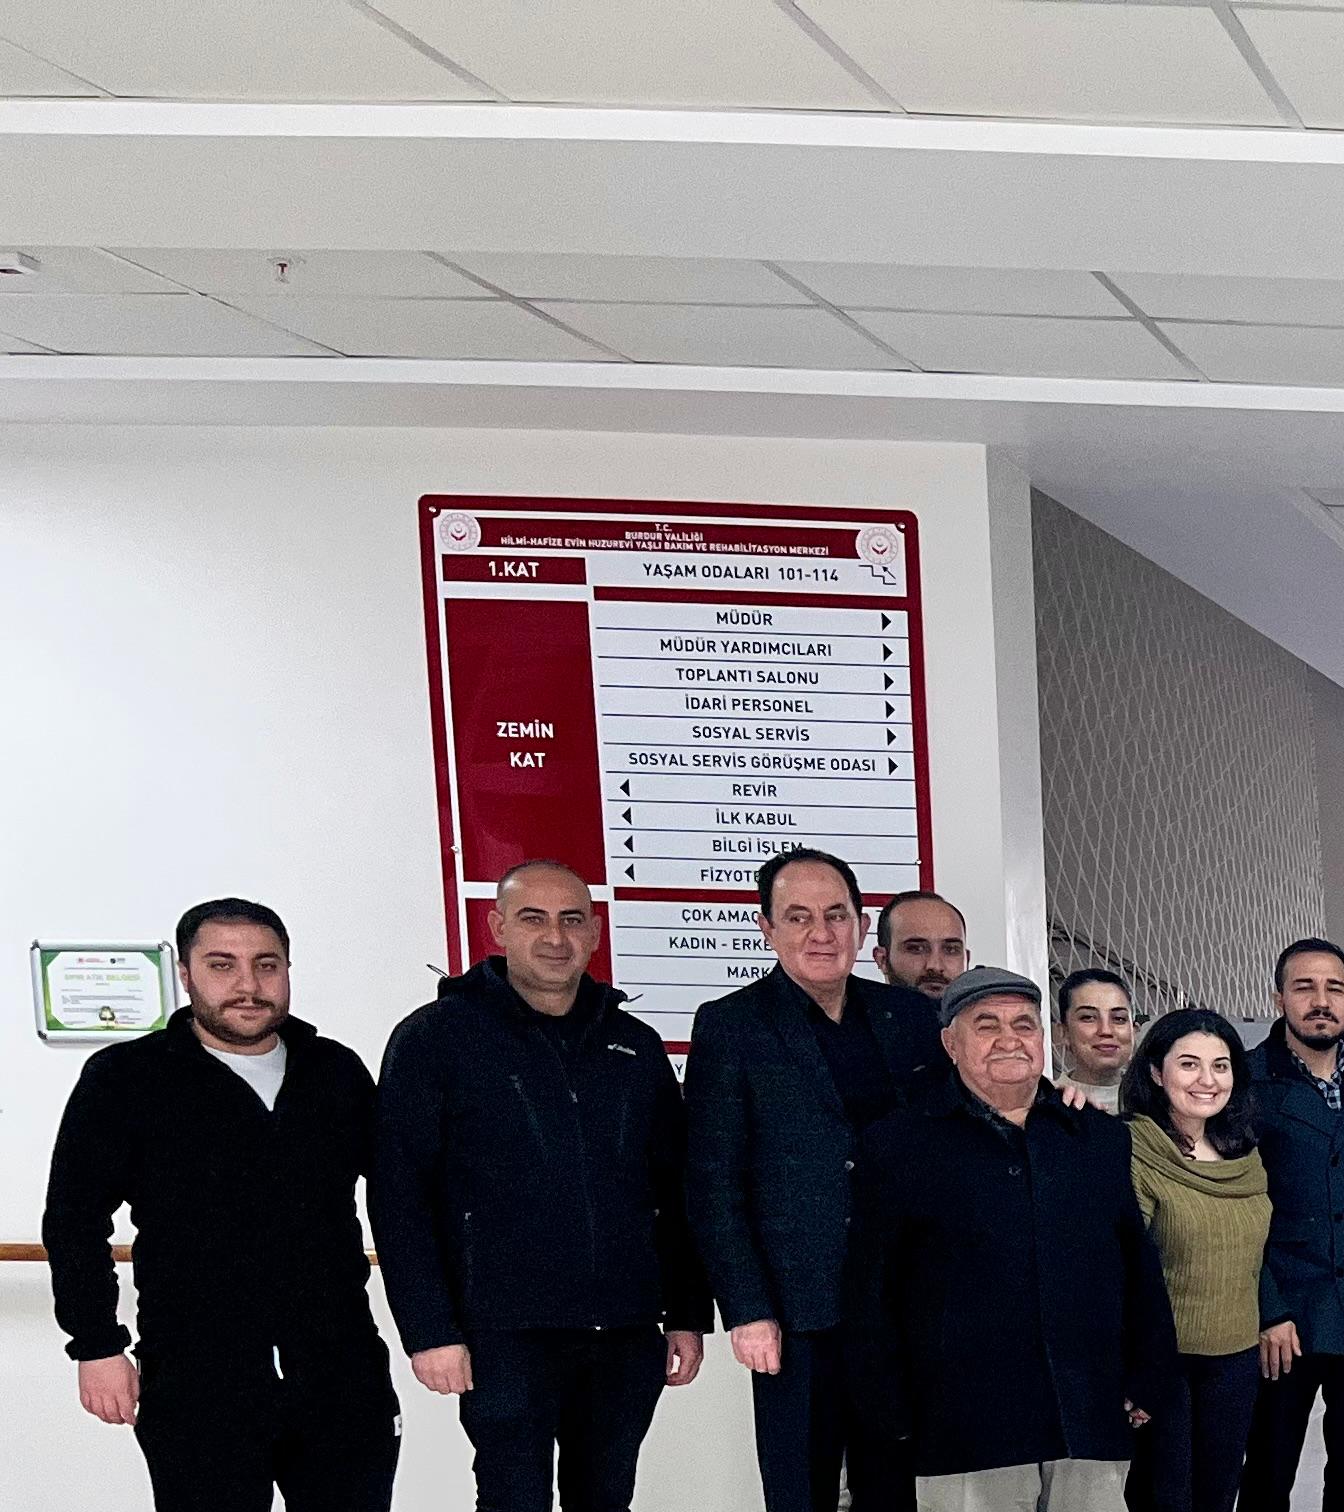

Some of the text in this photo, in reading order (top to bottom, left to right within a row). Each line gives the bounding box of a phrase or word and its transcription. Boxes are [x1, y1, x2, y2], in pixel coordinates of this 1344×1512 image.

[625, 531, 662, 541] BURDUR
[501, 535, 829, 556] HİLMİ-HAFİZE EVİN HUZUREVİ YAŞLI BAKIM VE REHABİLİTASYON MERKEZİ
[488, 560, 540, 578] 1.KAT
[643, 563, 839, 582] YAŞAM ODALARI 101-114
[716, 609, 773, 626] MÜDÜR
[660, 636, 832, 657] MÜDÜR YARDIMCILARI
[675, 668, 819, 685] TOPLANTI SALONU
[685, 693, 813, 713] İDARİ PERSONEL
[496, 718, 554, 739] ZEMİN
[692, 725, 810, 742] SOSYAL SERVİS
[509, 751, 546, 768] KAT
[628, 752, 875, 772] SOSYAL SERVİS GÖRÜŞME ODASI
[732, 781, 778, 798] REVİR
[715, 807, 798, 827] İLK KABUL
[712, 836, 803, 856] BİLGİ İŞLEM
[682, 909, 713, 924] ÇOK
[669, 936, 717, 950] KADIN
